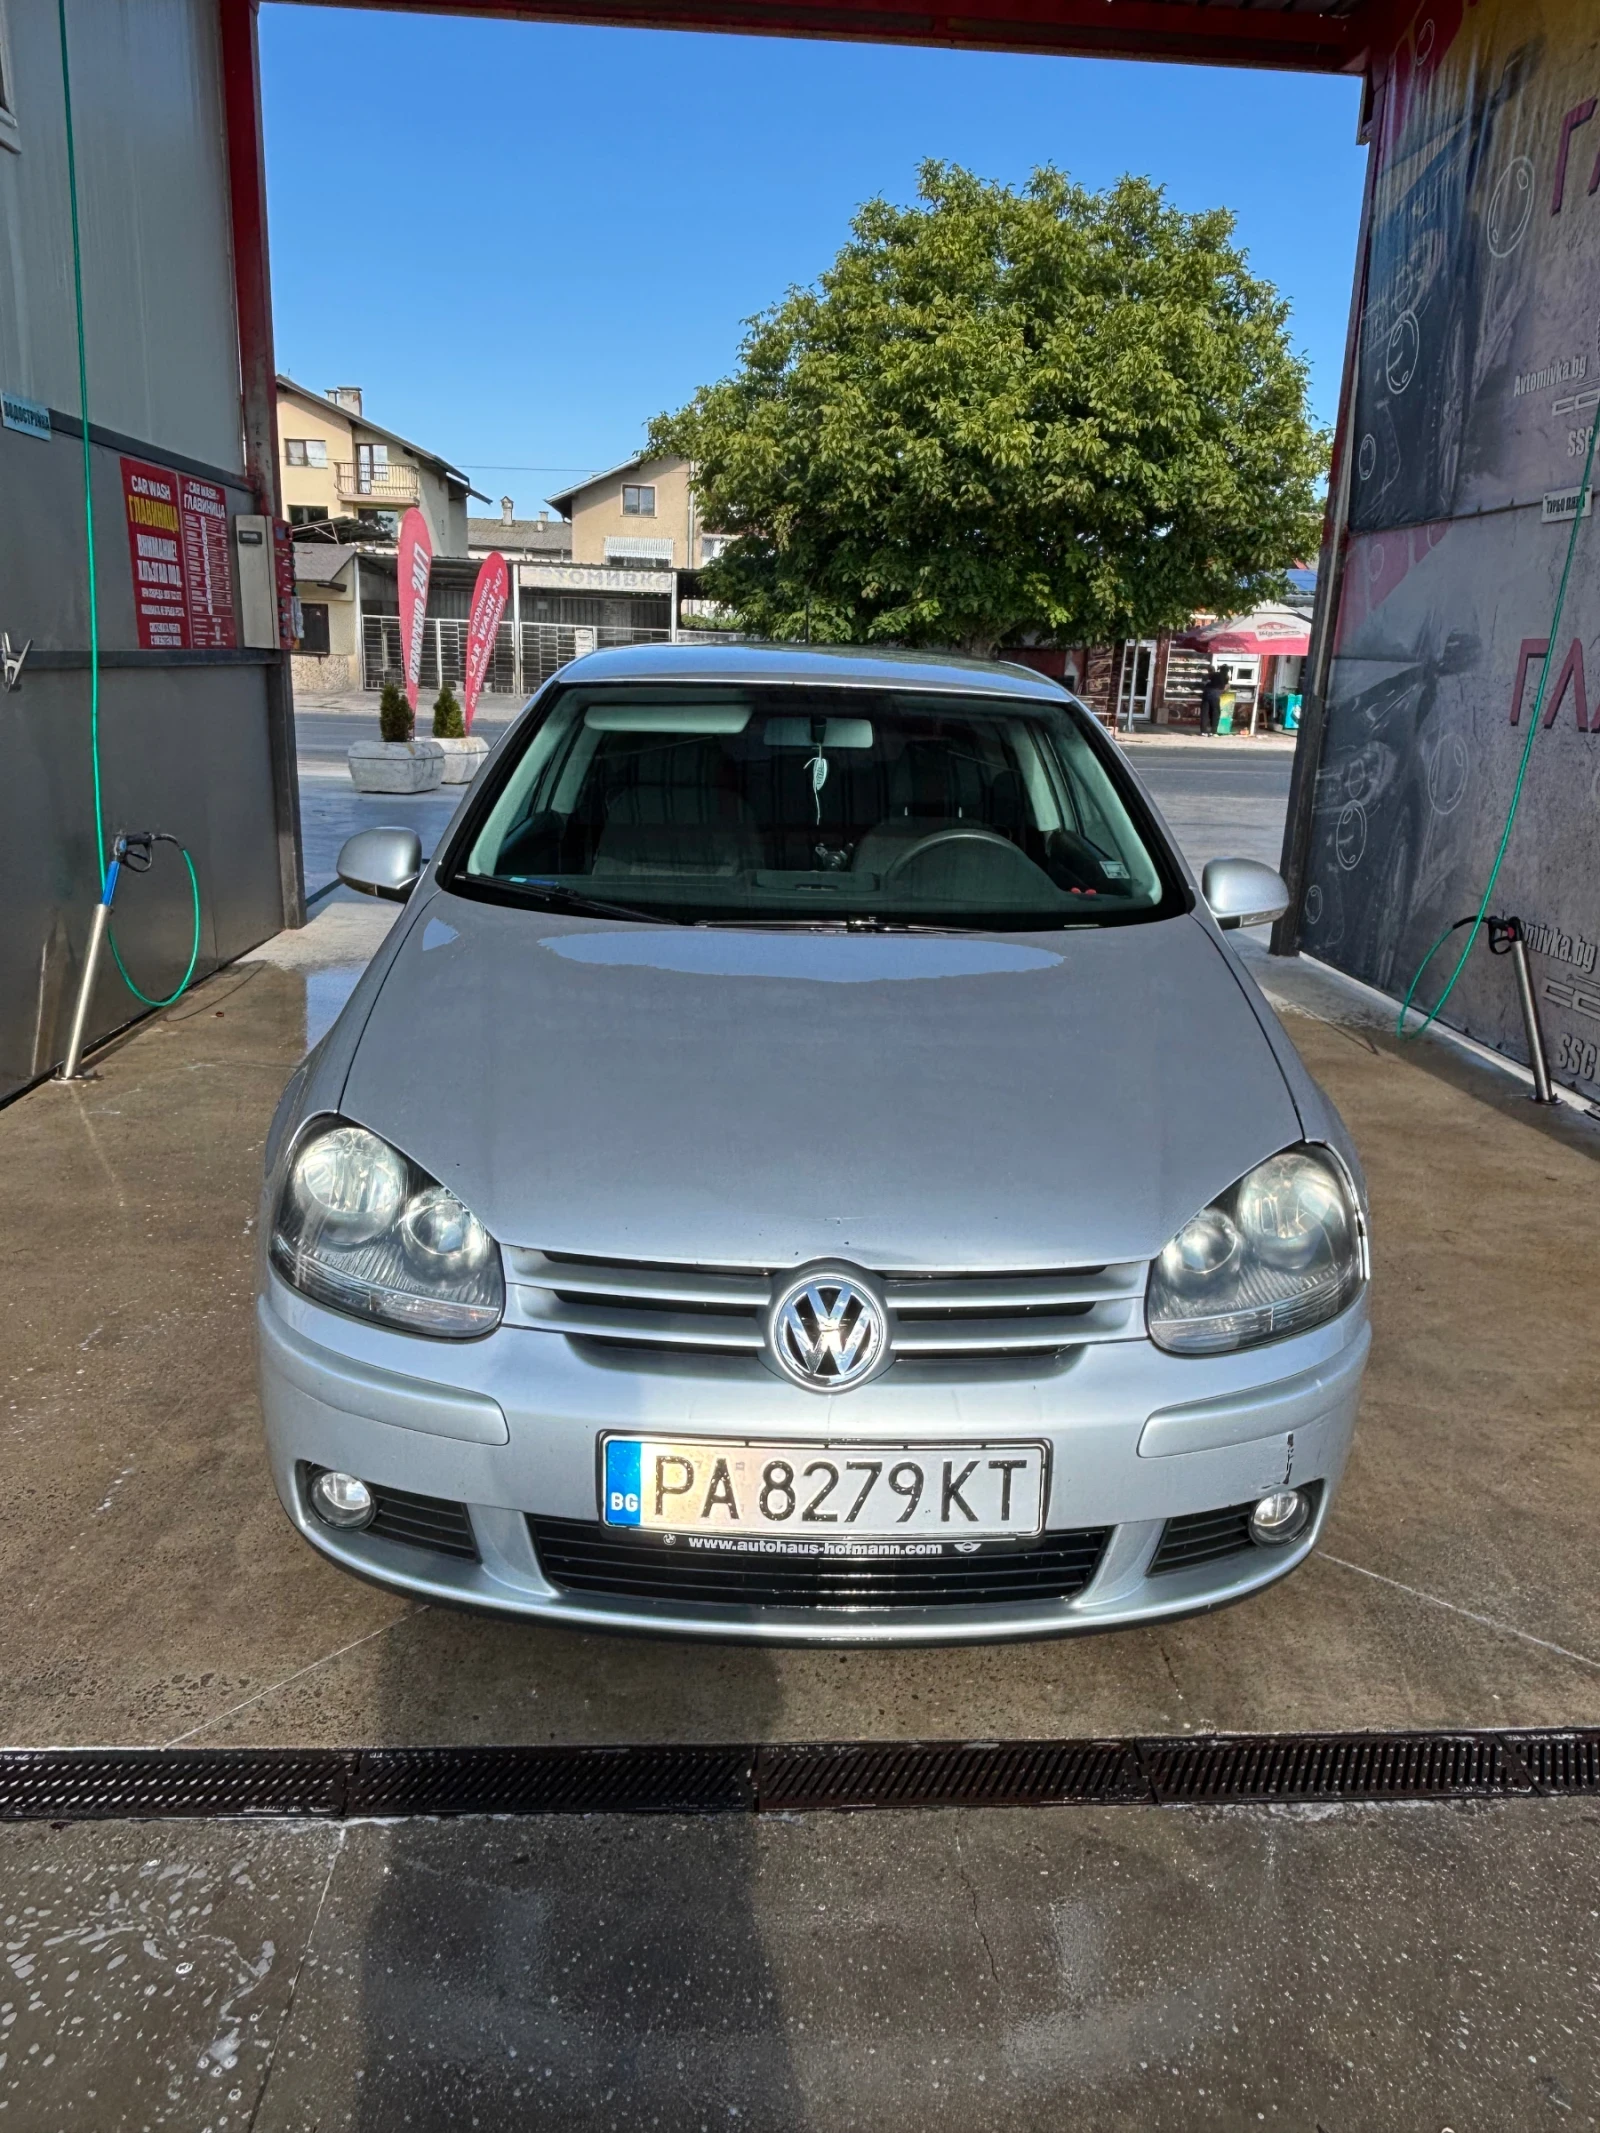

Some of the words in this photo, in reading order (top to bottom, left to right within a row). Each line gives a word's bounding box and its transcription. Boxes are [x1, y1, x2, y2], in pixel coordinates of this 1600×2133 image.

[131, 475, 149, 495] CAR
[148, 480, 171, 500] WASH
[184, 493, 226, 518] ГЛАВИНИЦА
[412, 542, 430, 598] 24/7
[469, 643, 482, 677] CAR
[477, 594, 496, 641] WASH
[492, 567, 504, 593] 24/7
[1510, 638, 1600, 733] ГЛ
[611, 1492, 638, 1511] BG
[654, 1455, 740, 1520] PA
[758, 1459, 925, 1523] 8279
[941, 1459, 1027, 1522] KT
[688, 1536, 942, 1555] www.autohaus-hofmann.com
